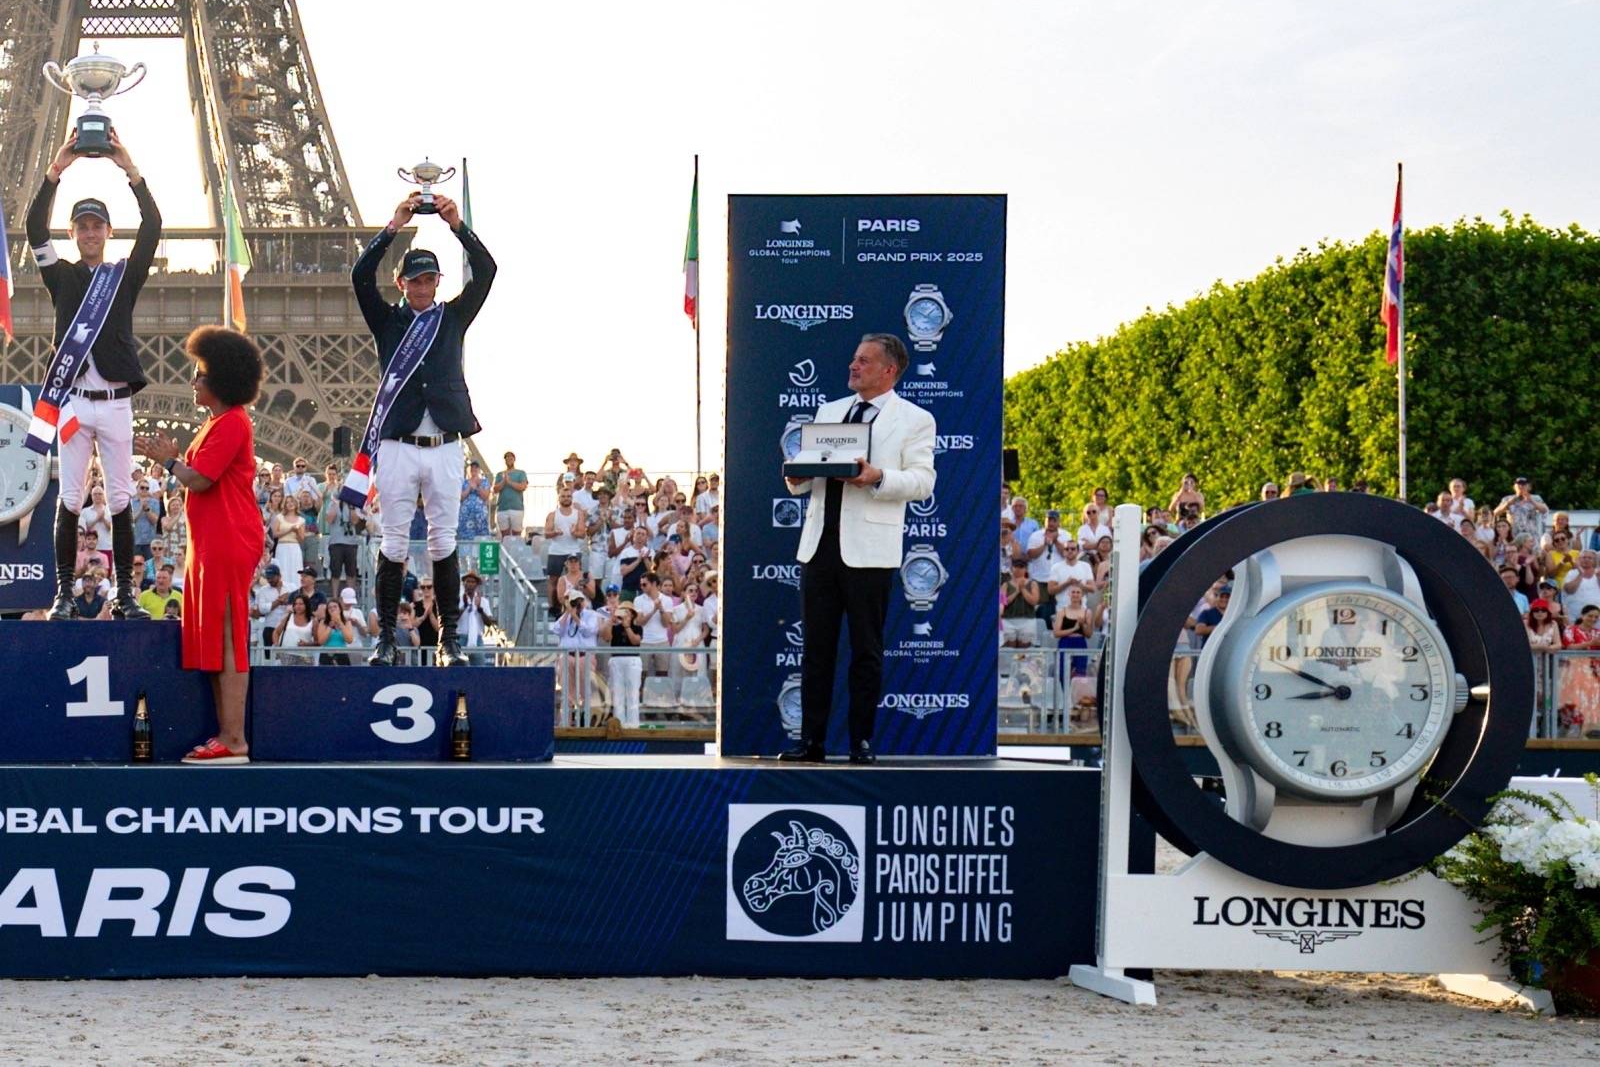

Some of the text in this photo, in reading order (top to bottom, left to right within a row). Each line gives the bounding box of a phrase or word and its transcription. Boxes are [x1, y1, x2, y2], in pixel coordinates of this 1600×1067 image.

[857, 219, 920, 232] PARIS
[766, 240, 814, 248] LONGINES
[857, 238, 909, 248] FRANCE
[749, 249, 831, 257] GLOBAL CHAMPIONS
[857, 252, 983, 262] GRAND PRIX 2025
[755, 305, 853, 320] LONGINES
[49, 354, 74, 401] 2025
[903, 381, 949, 389] LONGINES
[779, 393, 827, 407] PARIS
[1332, 609, 1356, 625] 12
[1297, 619, 1312, 635] 11
[1381, 619, 1389, 635] 1
[1269, 645, 1291, 661] 10
[1304, 646, 1382, 658] LONGINES
[1402, 646, 1418, 662] 2
[65, 655, 124, 717] 1
[1255, 684, 1272, 701] 9
[1410, 684, 1429, 702] 3
[370, 683, 436, 744] 3
[1264, 721, 1283, 739] 8
[1395, 722, 1416, 739] 4
[1292, 750, 1309, 767] 7
[1370, 750, 1387, 767] 5
[1330, 760, 1347, 777] 6
[105, 807, 403, 834] CHAMPIONS
[411, 807, 545, 834] TOUR
[876, 805, 1015, 847] LONGINES
[875, 853, 1013, 895] PARIS EIFFEL
[1193, 896, 1426, 930] LONGINES
[874, 901, 1012, 943] JUMPING
